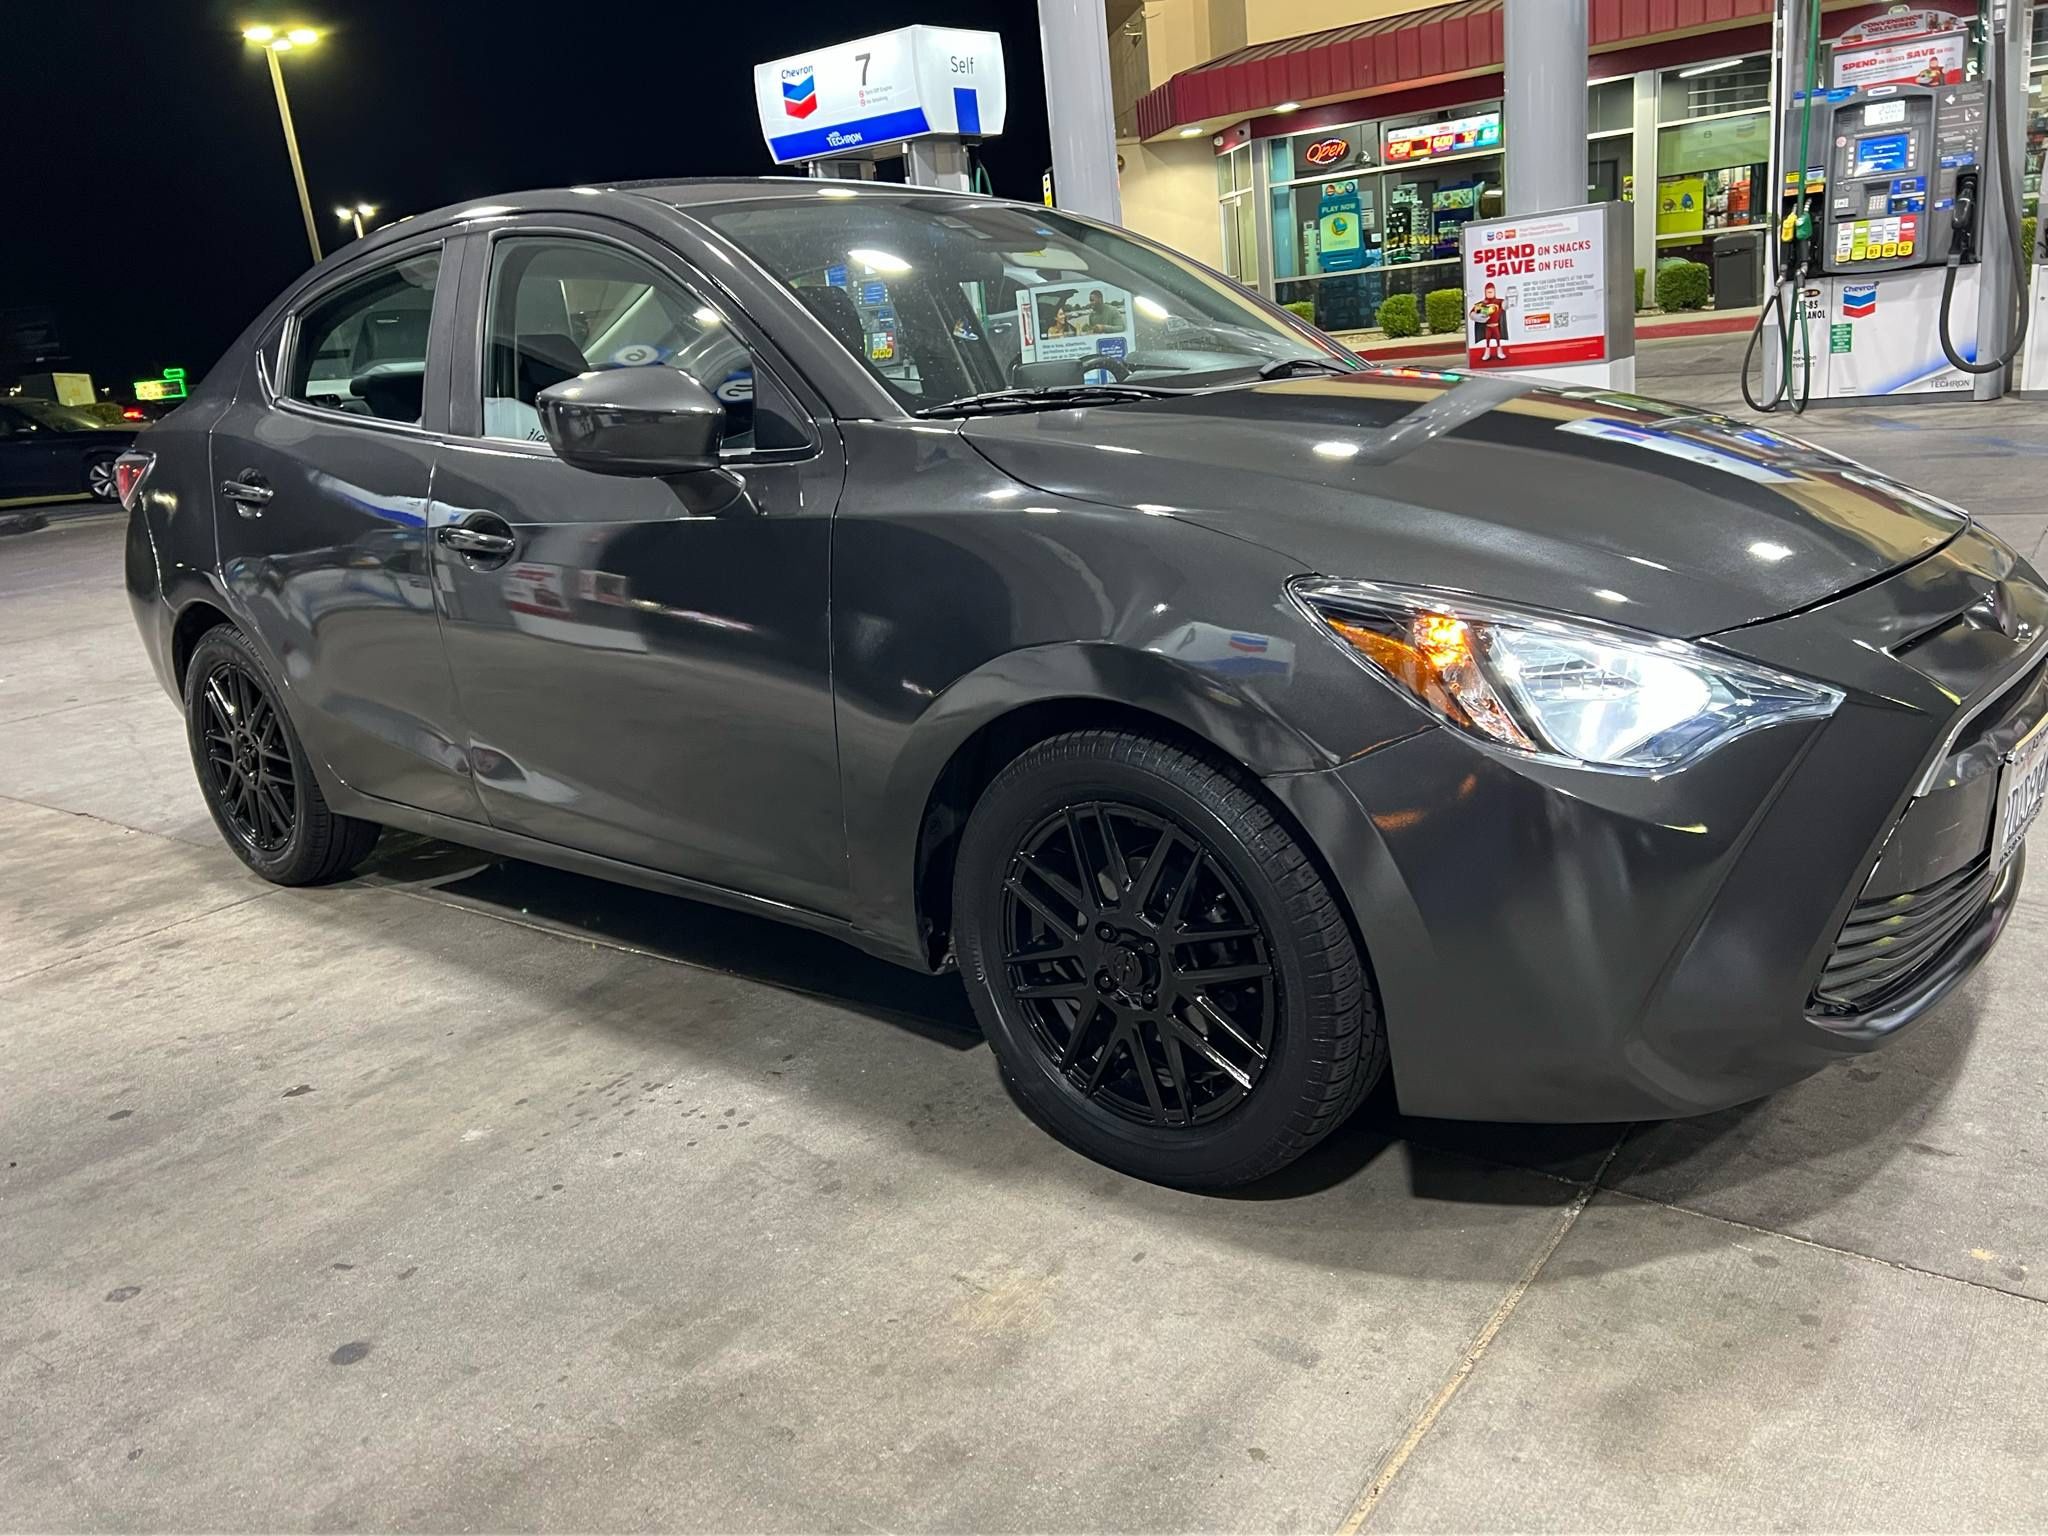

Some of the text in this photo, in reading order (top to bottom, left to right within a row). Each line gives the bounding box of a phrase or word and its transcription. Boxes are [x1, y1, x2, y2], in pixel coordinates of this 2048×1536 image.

[855, 52, 871, 86] 7
[950, 56, 975, 75] Self
[1842, 58, 1877, 71] SPEND
[1906, 48, 1936, 59] SAVE
[781, 64, 813, 79] Chevron
[826, 132, 863, 147] TECHRON
[1307, 141, 1347, 162] Open
[1473, 240, 1591, 264] SPEND ON SNACKS
[1486, 259, 1574, 278] SAVE ON FUEL
[1844, 284, 1878, 293] Chevron
[1931, 380, 1970, 388] TECHRON
